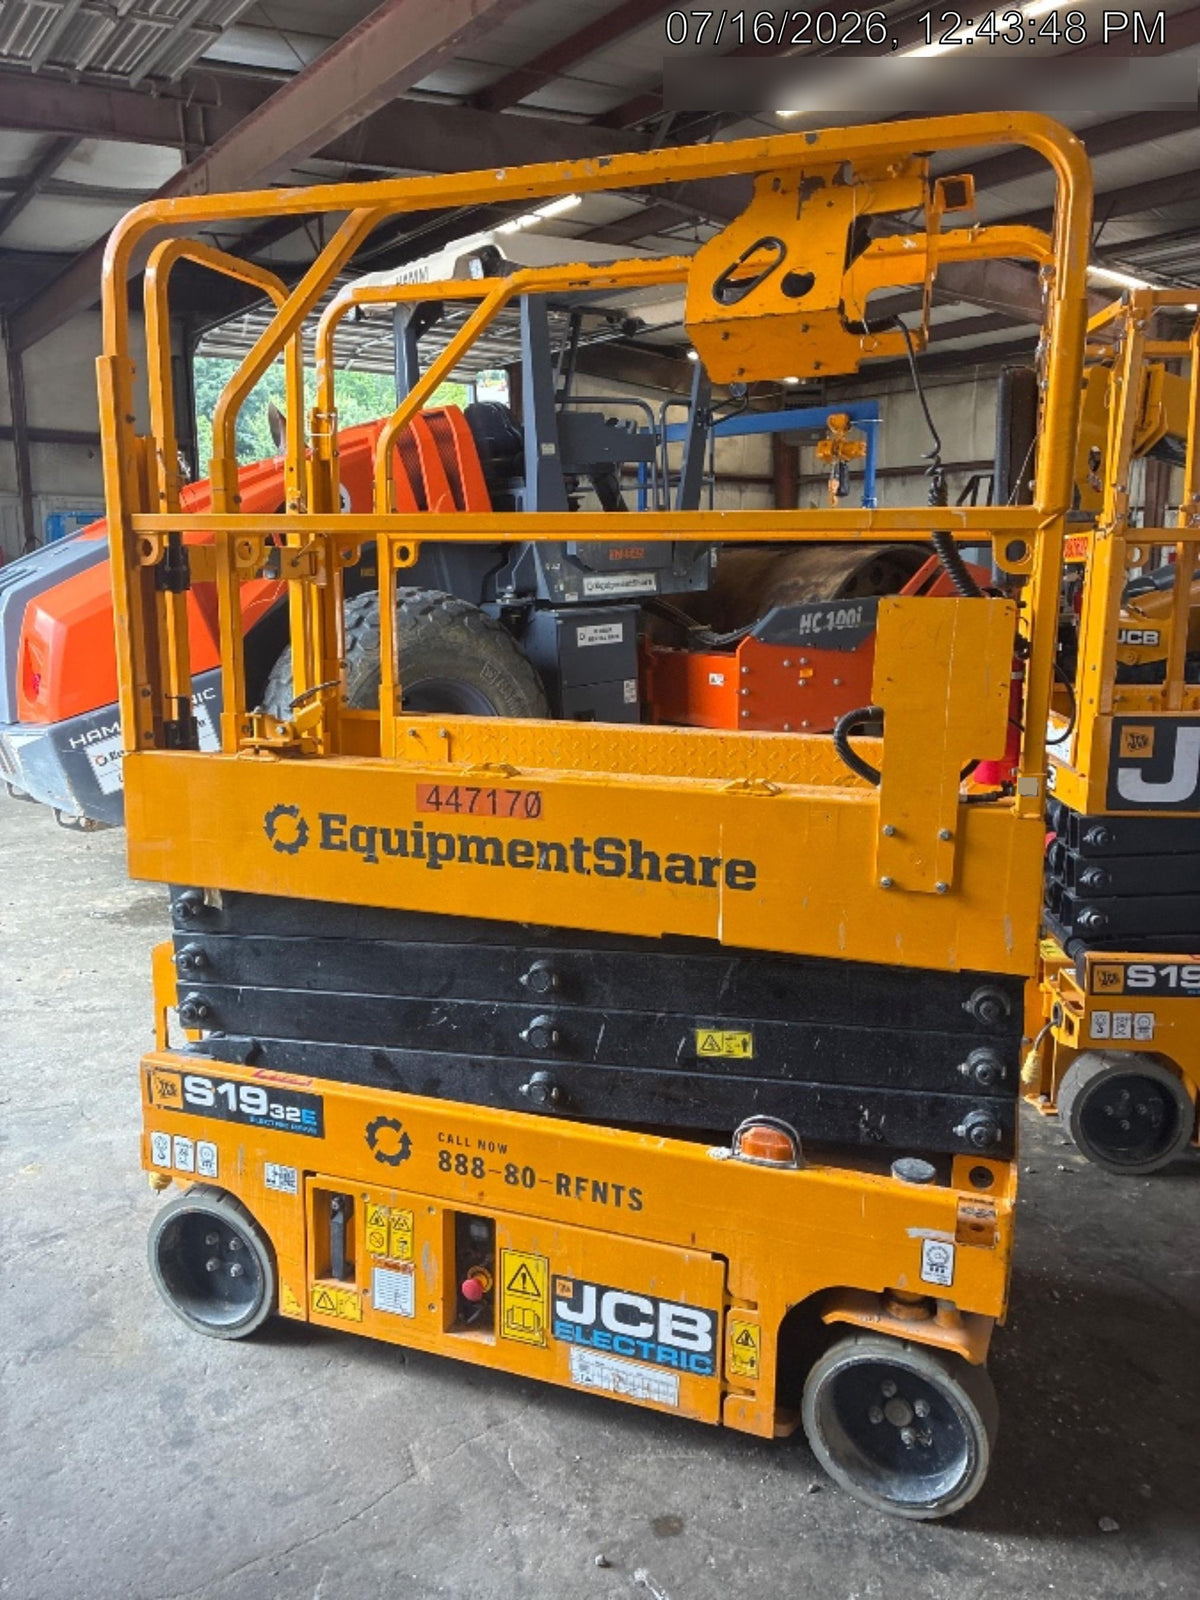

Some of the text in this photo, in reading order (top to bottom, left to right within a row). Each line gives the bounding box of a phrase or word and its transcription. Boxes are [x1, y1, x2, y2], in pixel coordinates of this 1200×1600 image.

[799, 605, 864, 635] HC 100i
[425, 785, 542, 819] 447170
[318, 812, 757, 892] EquipmentShare
[437, 1131, 508, 1155] CALL NOW
[555, 1284, 713, 1352] JCB
[553, 1319, 713, 1376] ELECTRIC
